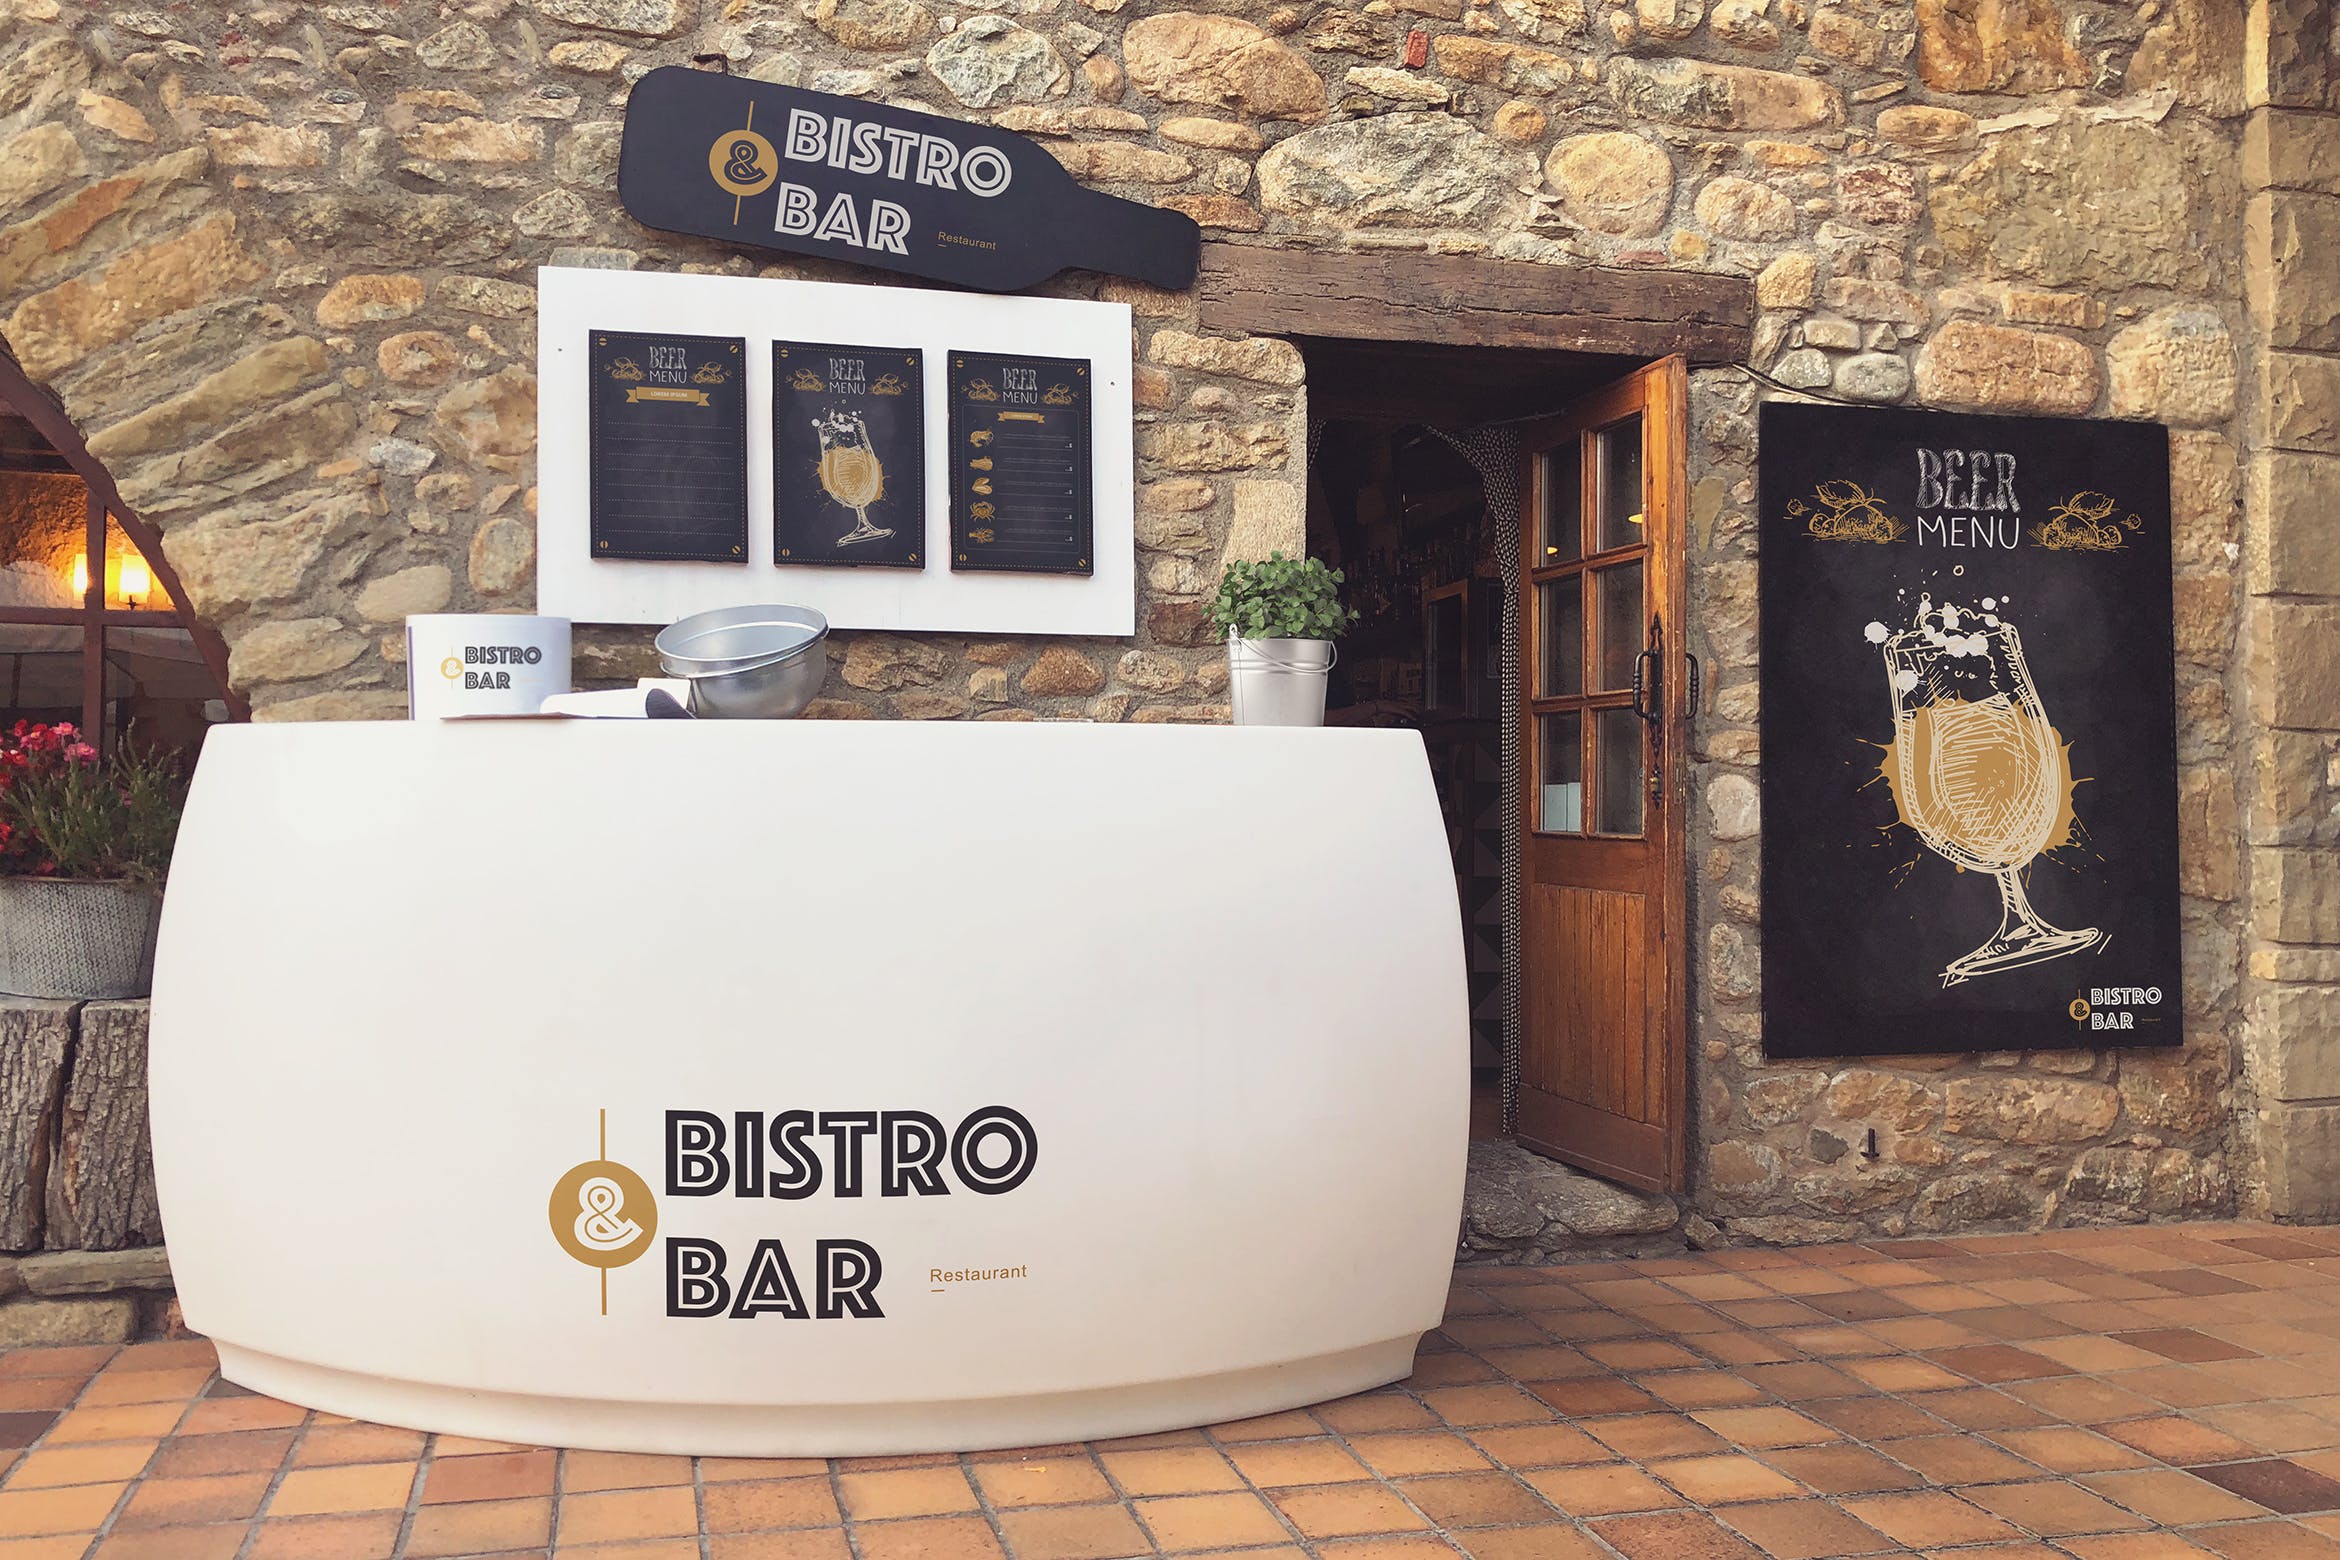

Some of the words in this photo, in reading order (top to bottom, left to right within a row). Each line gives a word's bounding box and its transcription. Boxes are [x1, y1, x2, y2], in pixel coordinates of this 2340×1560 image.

[784, 107, 1012, 198] BISTRO
[773, 181, 911, 256] BAR
[937, 231, 997, 251] Restaurant
[649, 346, 687, 370] BEER
[650, 370, 687, 384] MENU
[829, 358, 865, 381] BEER
[1002, 368, 1037, 391] BEER
[829, 382, 866, 395] MENU
[1002, 391, 1038, 404] MENU
[1916, 448, 2021, 513] BEER
[1917, 515, 2020, 550] MENU
[465, 646, 542, 664] BISTRO
[465, 672, 511, 689] BAR
[2091, 987, 2162, 1005] BISTRO
[2091, 1012, 2134, 1030] BAR
[665, 1105, 1038, 1200] BISTRO
[665, 1237, 886, 1320] BAR
[930, 1264, 1028, 1283] Restaurant
